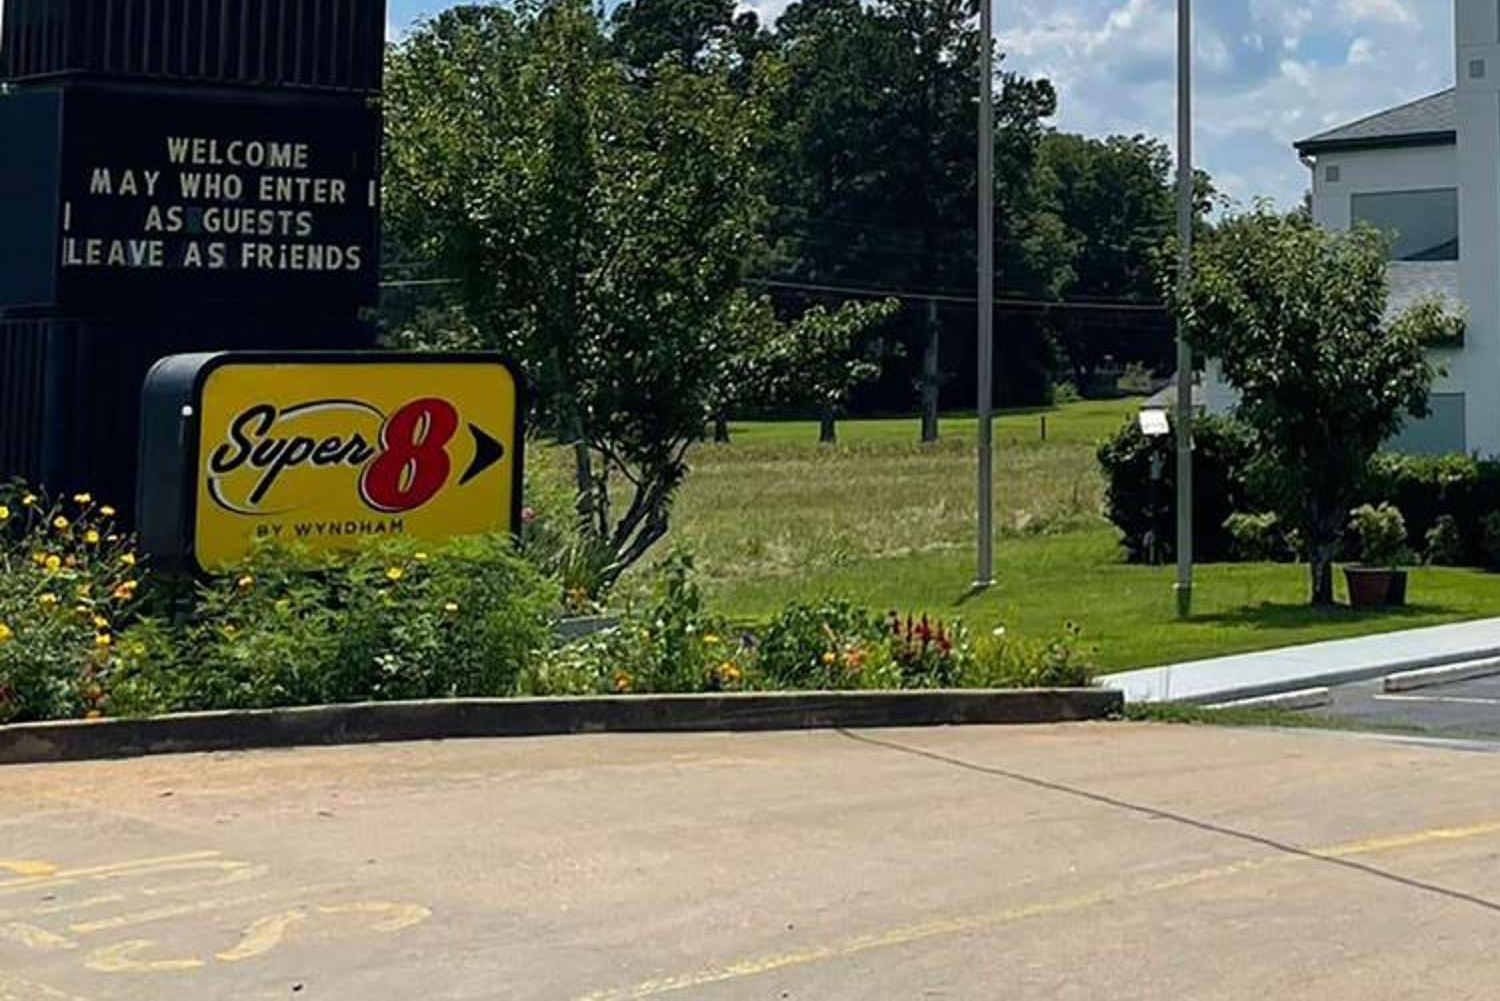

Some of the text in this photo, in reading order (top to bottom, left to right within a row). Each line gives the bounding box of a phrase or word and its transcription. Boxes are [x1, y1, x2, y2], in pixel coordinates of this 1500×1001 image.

[167, 136, 308, 168] WELCOME
[89, 168, 160, 196] MAY
[180, 172, 243, 199] WHO
[259, 176, 346, 204] ENTER
[144, 205, 183, 232] AS
[202, 207, 312, 236] GUESTS
[183, 241, 225, 269] AS
[210, 396, 460, 513] Super 8
[256, 518, 404, 537] BY WYNDHAM
